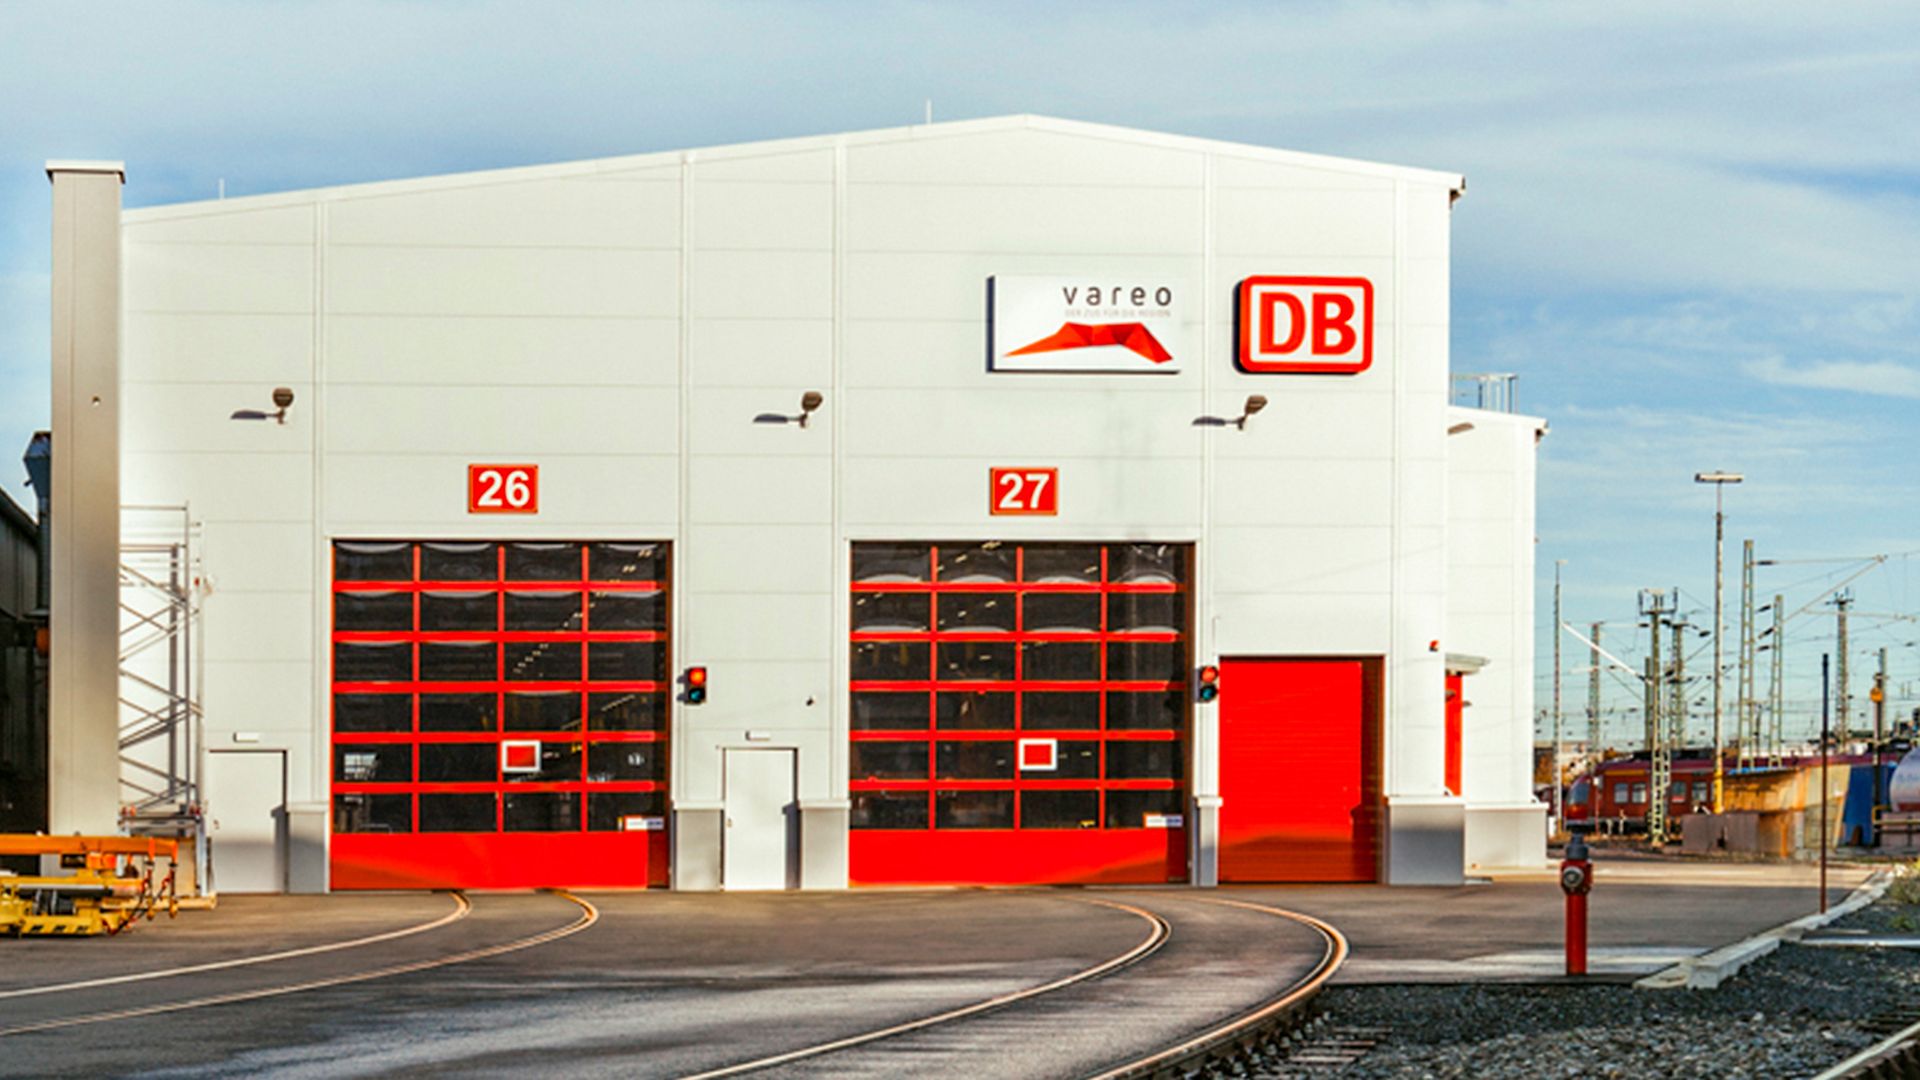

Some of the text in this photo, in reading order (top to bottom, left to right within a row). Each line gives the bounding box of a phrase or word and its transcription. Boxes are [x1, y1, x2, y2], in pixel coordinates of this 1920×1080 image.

[1063, 286, 1172, 306] vareo
[1259, 292, 1357, 356] DB
[477, 470, 531, 508] 26
[999, 472, 1050, 509] 27
